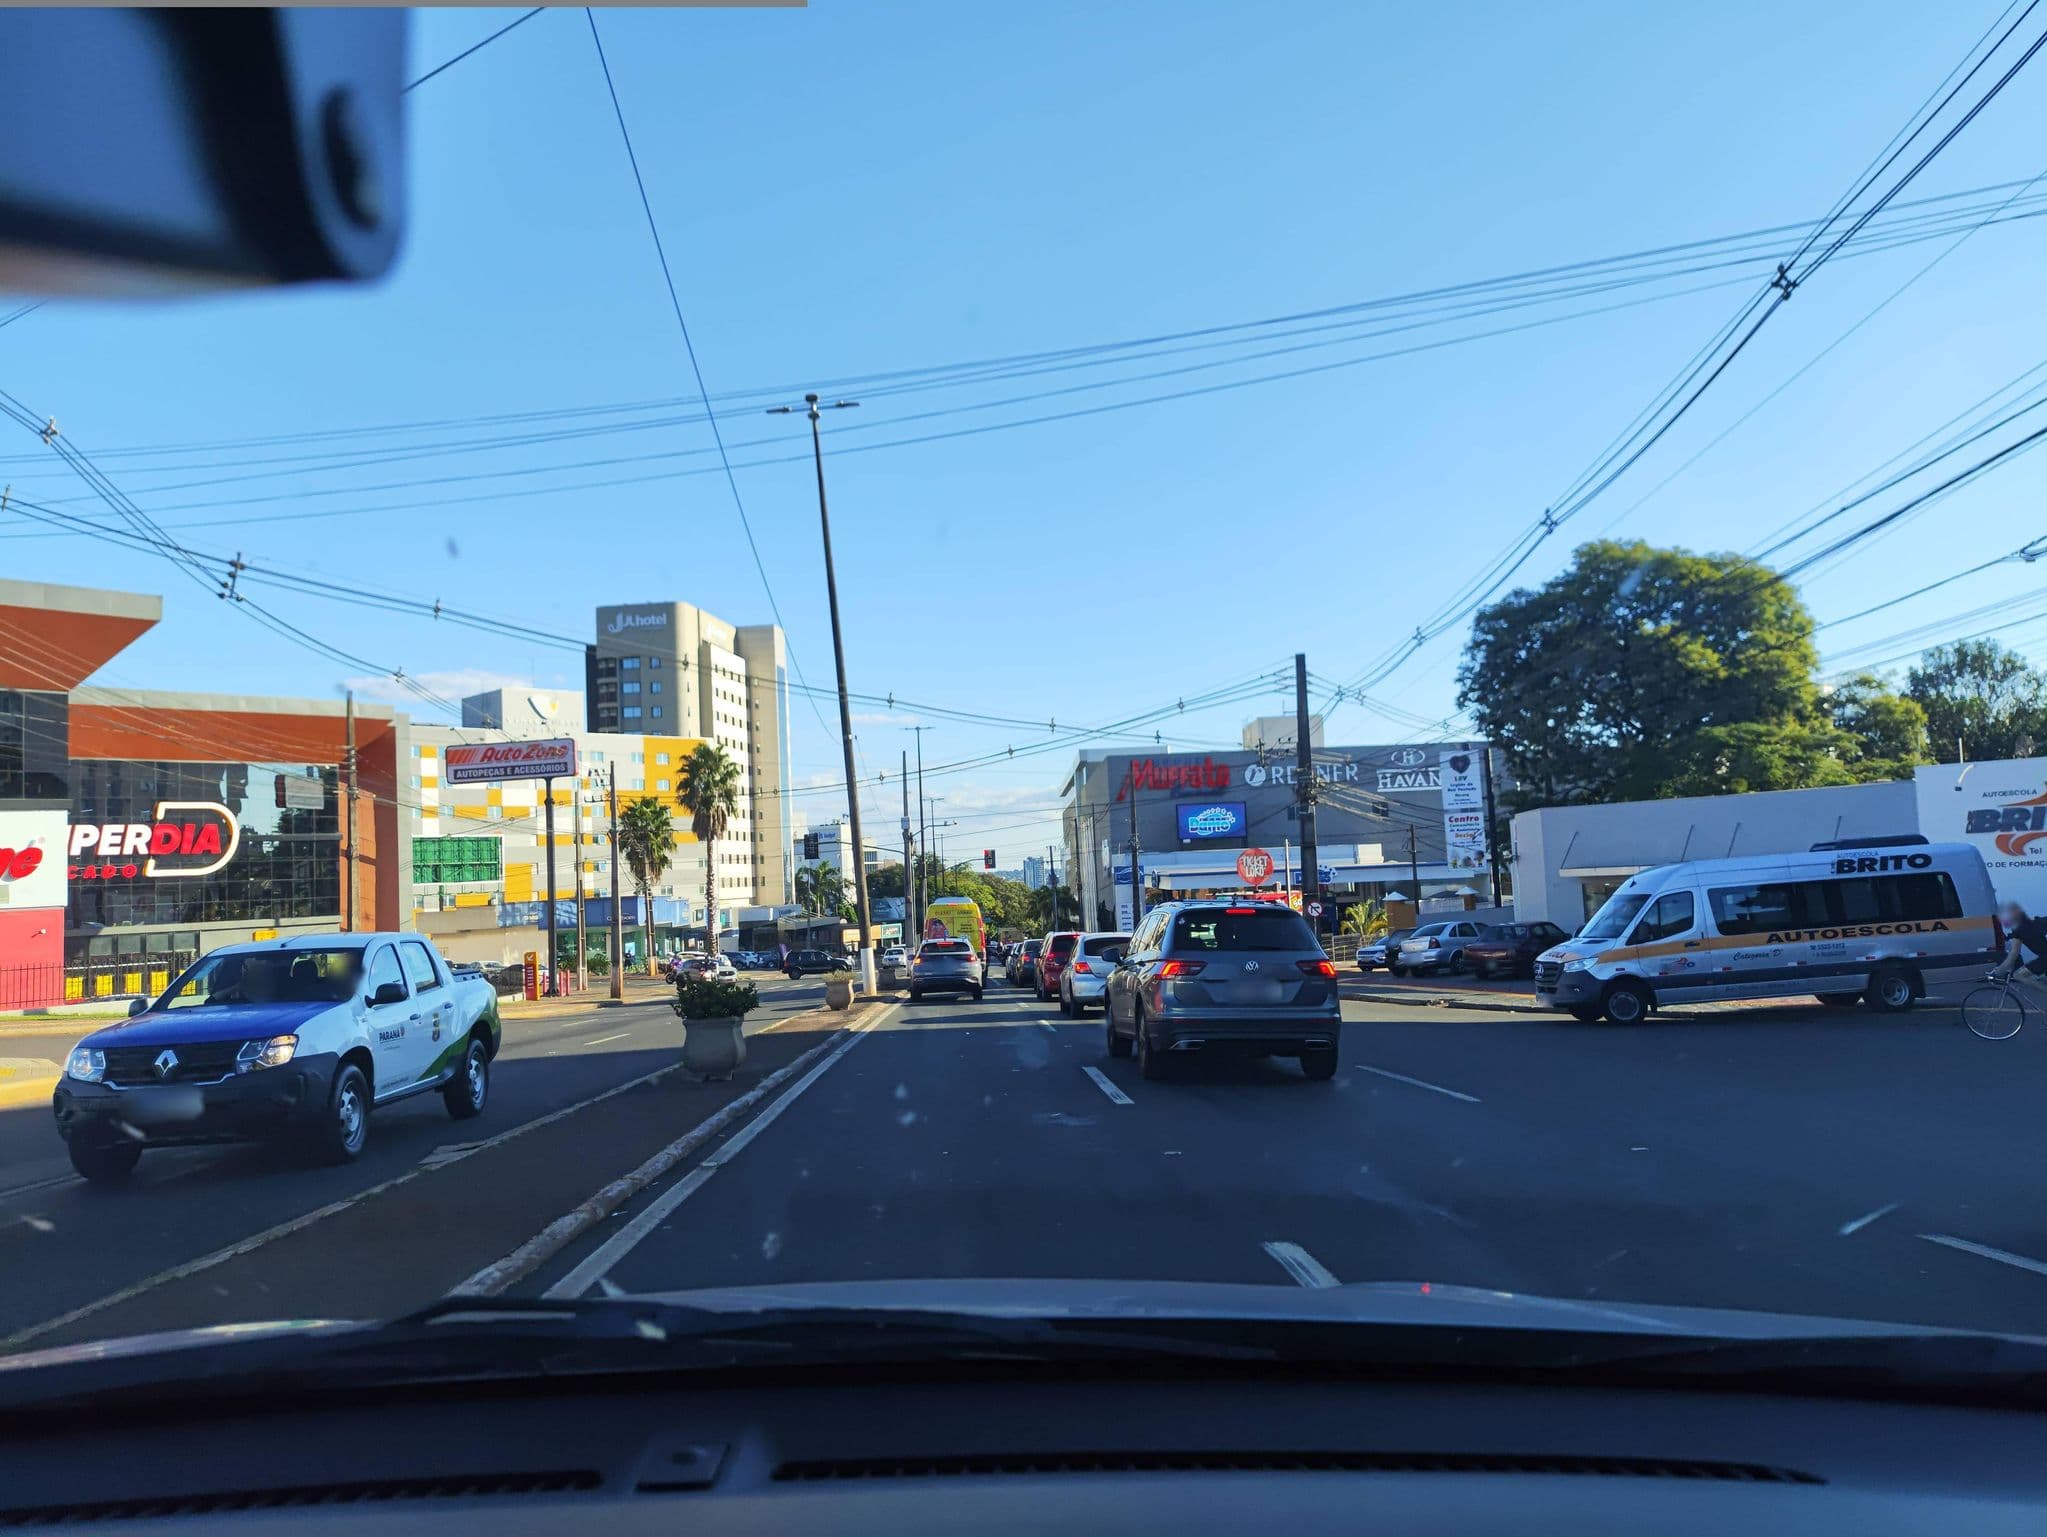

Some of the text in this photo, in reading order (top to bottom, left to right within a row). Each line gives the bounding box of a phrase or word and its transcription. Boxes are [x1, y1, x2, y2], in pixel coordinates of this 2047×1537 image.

[636, 612, 667, 627] hotel
[456, 763, 567, 779] AUTOPEÇAS E ACESSÓRIOS
[1271, 763, 1359, 786] RENER
[1377, 771, 1441, 788] HAVAN
[1982, 788, 2038, 798] AUTOESCOLA
[1448, 815, 1480, 823] Centro
[67, 823, 222, 856] PERDIA
[2028, 847, 2043, 855] Tel
[1240, 855, 1269, 867] TICKET
[1836, 853, 1933, 874] BRITO
[2009, 860, 2047, 869] FORMAÇ
[1244, 866, 1265, 877] LOKO
[1766, 921, 1950, 944] AUTOESCOLA
